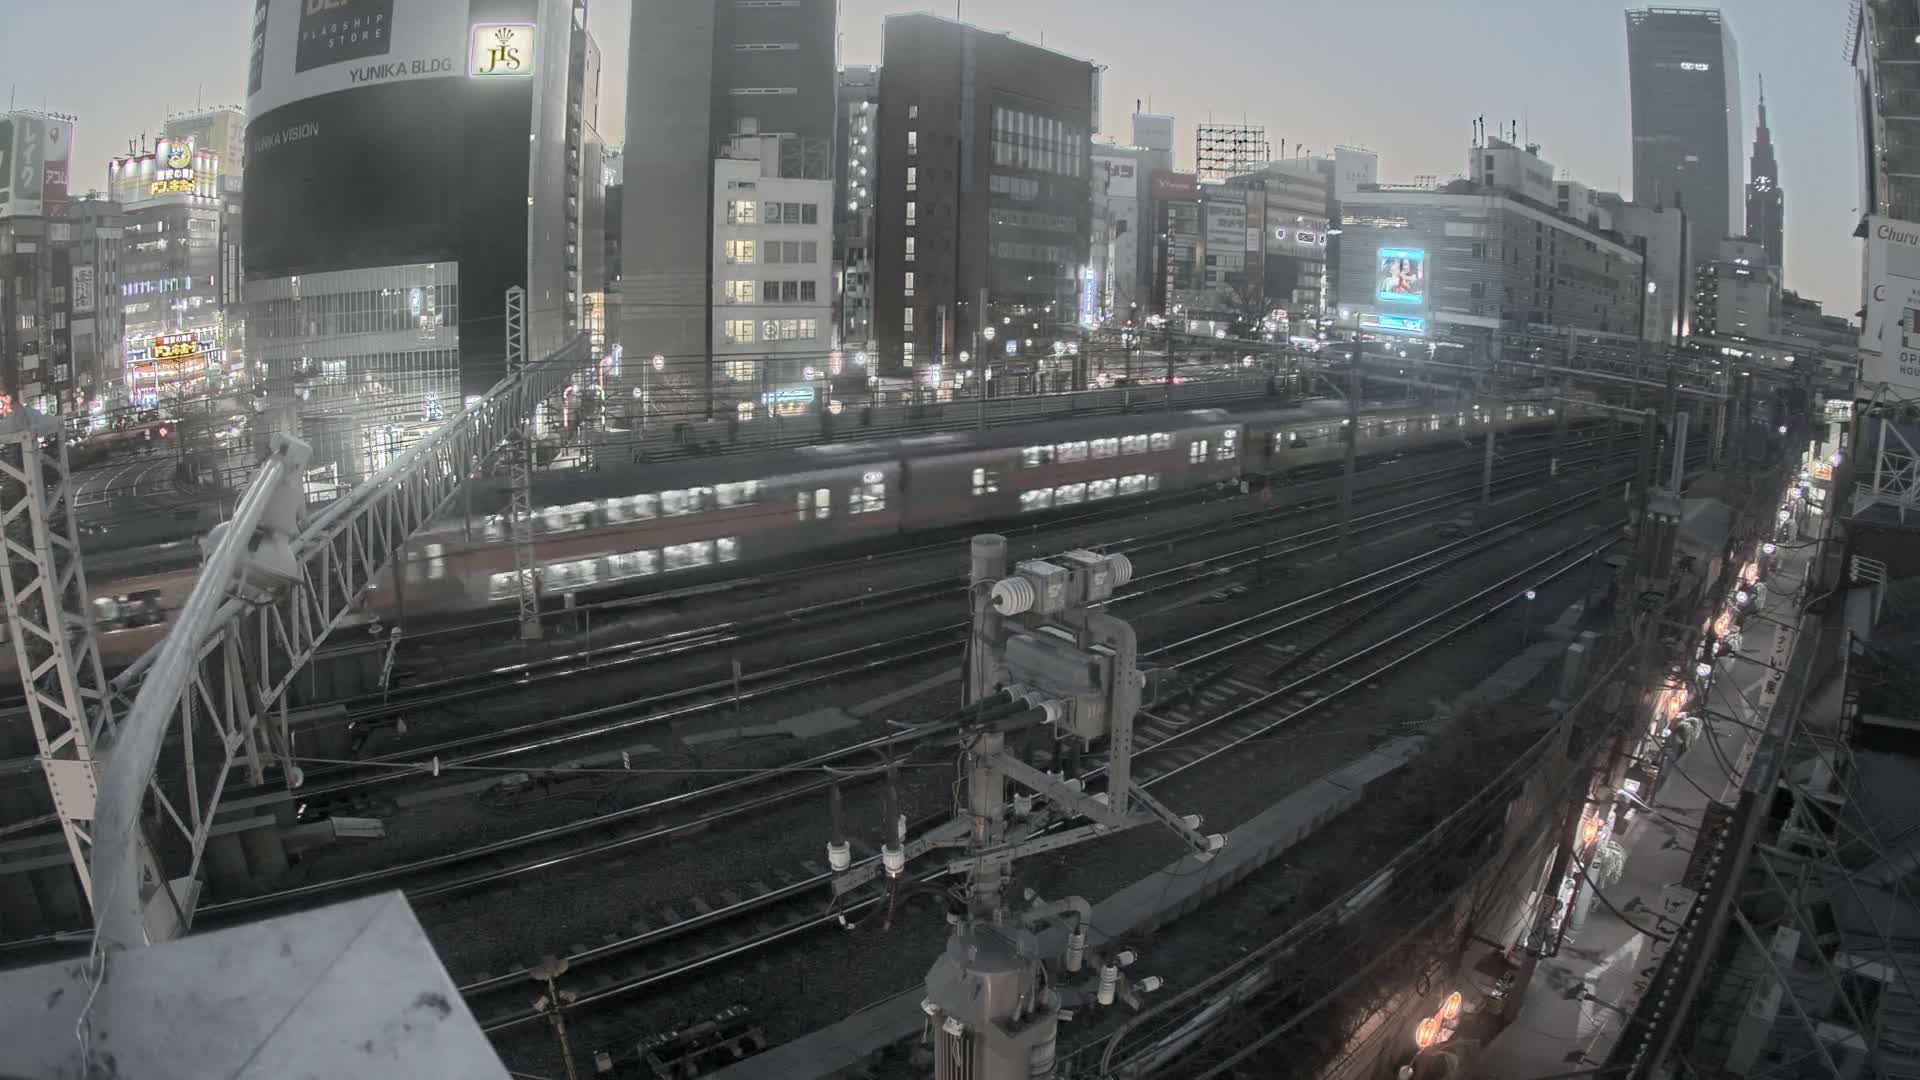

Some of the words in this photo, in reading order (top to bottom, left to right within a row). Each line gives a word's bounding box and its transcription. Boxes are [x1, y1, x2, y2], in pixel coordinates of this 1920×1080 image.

[303, 14, 383, 40] FLAGSHIP
[328, 28, 382, 48] STORE
[350, 62, 407, 83] YUNIKA
[282, 120, 319, 144] VISION
[1900, 352, 1920, 364] OP
